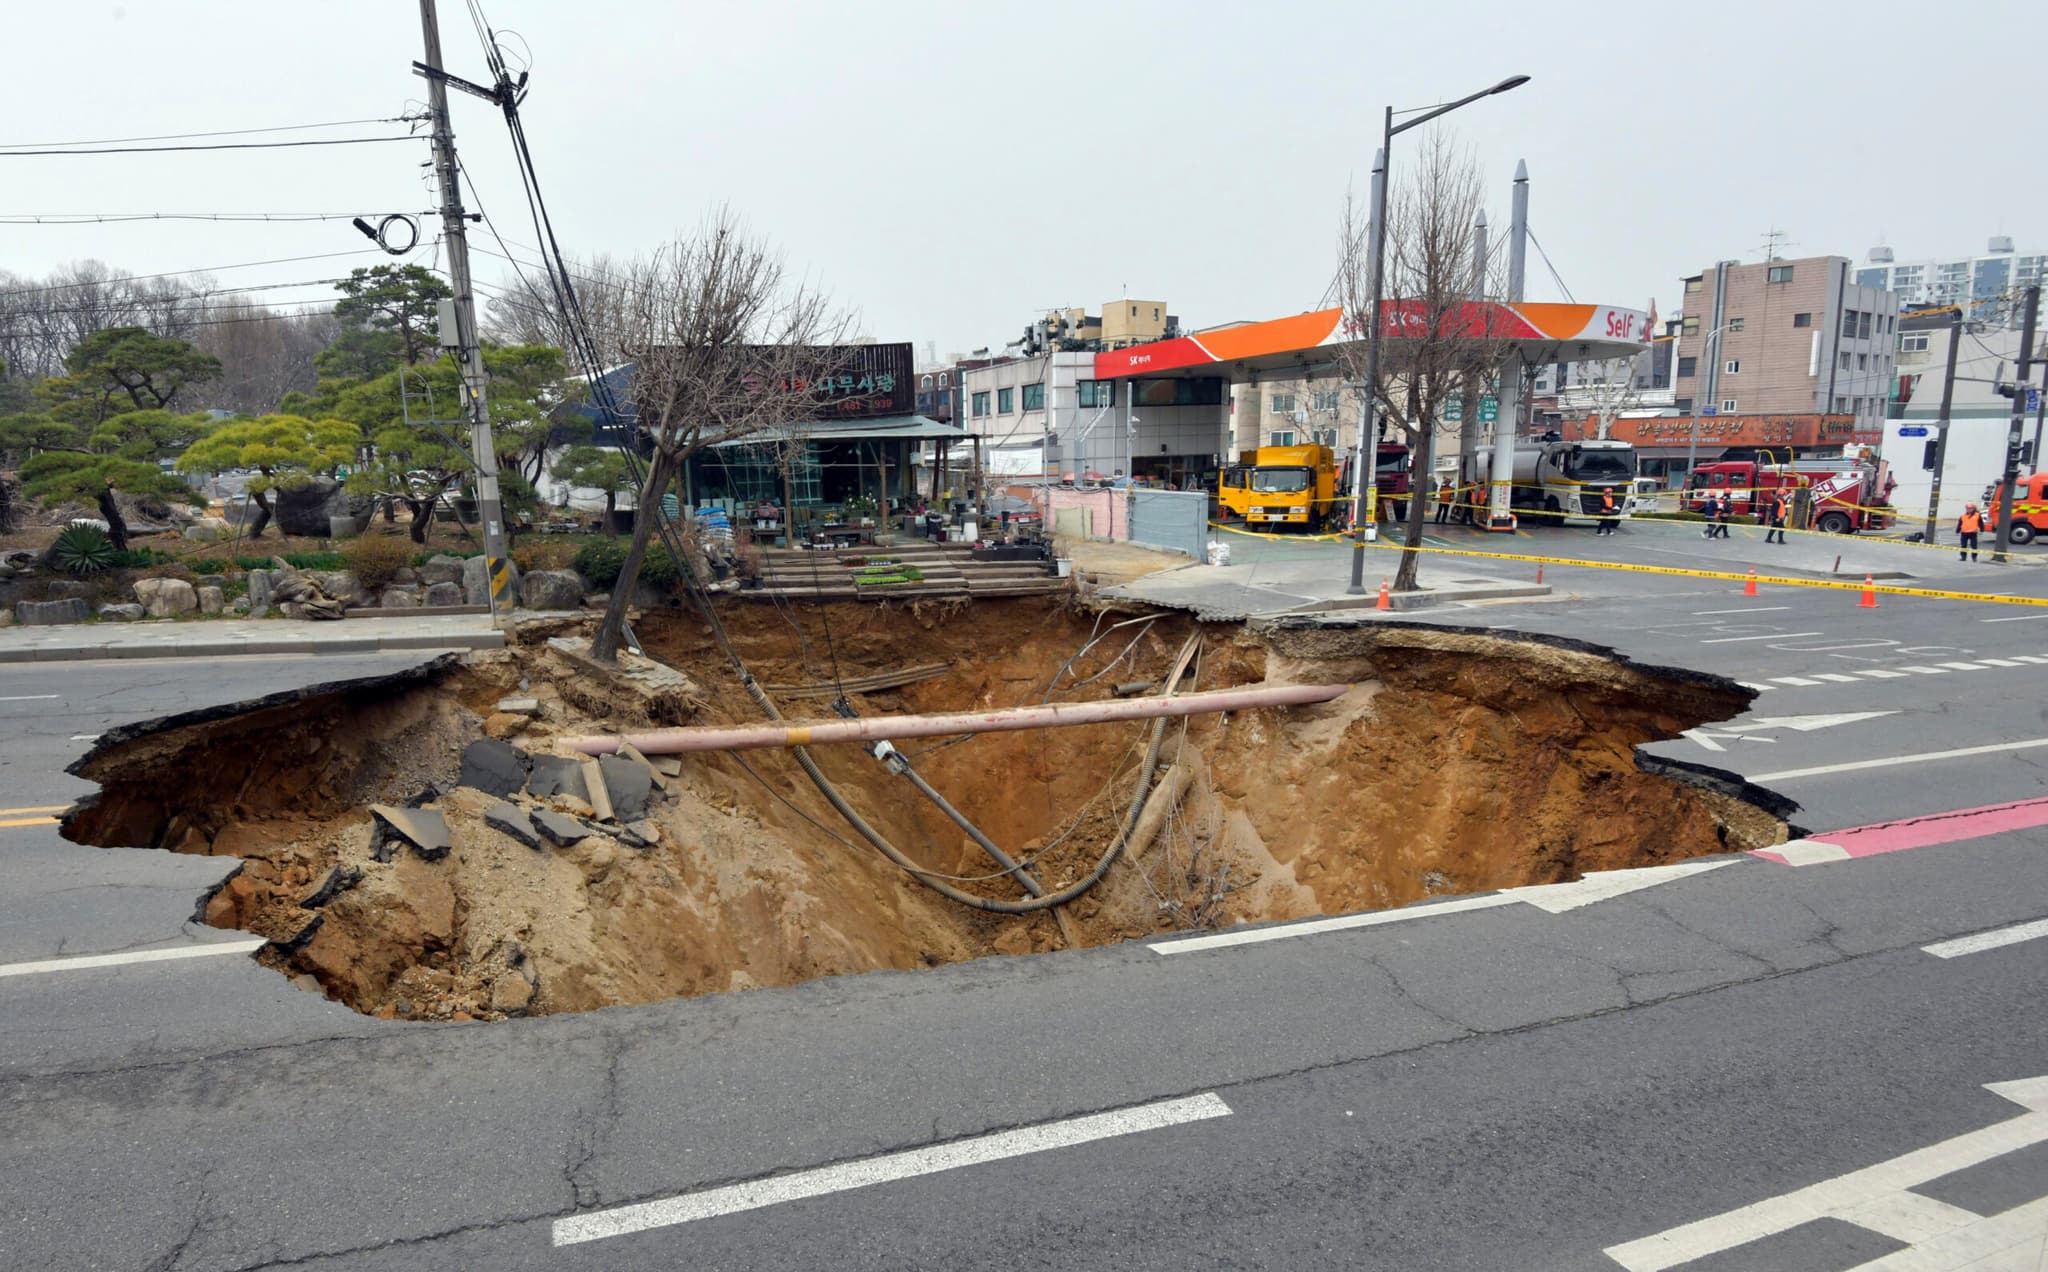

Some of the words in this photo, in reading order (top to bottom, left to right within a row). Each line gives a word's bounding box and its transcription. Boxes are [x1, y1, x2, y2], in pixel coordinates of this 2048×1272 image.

[1389, 311, 1407, 327] SK
[1606, 311, 1634, 338] Self
[818, 373, 896, 395] 나무사랑
